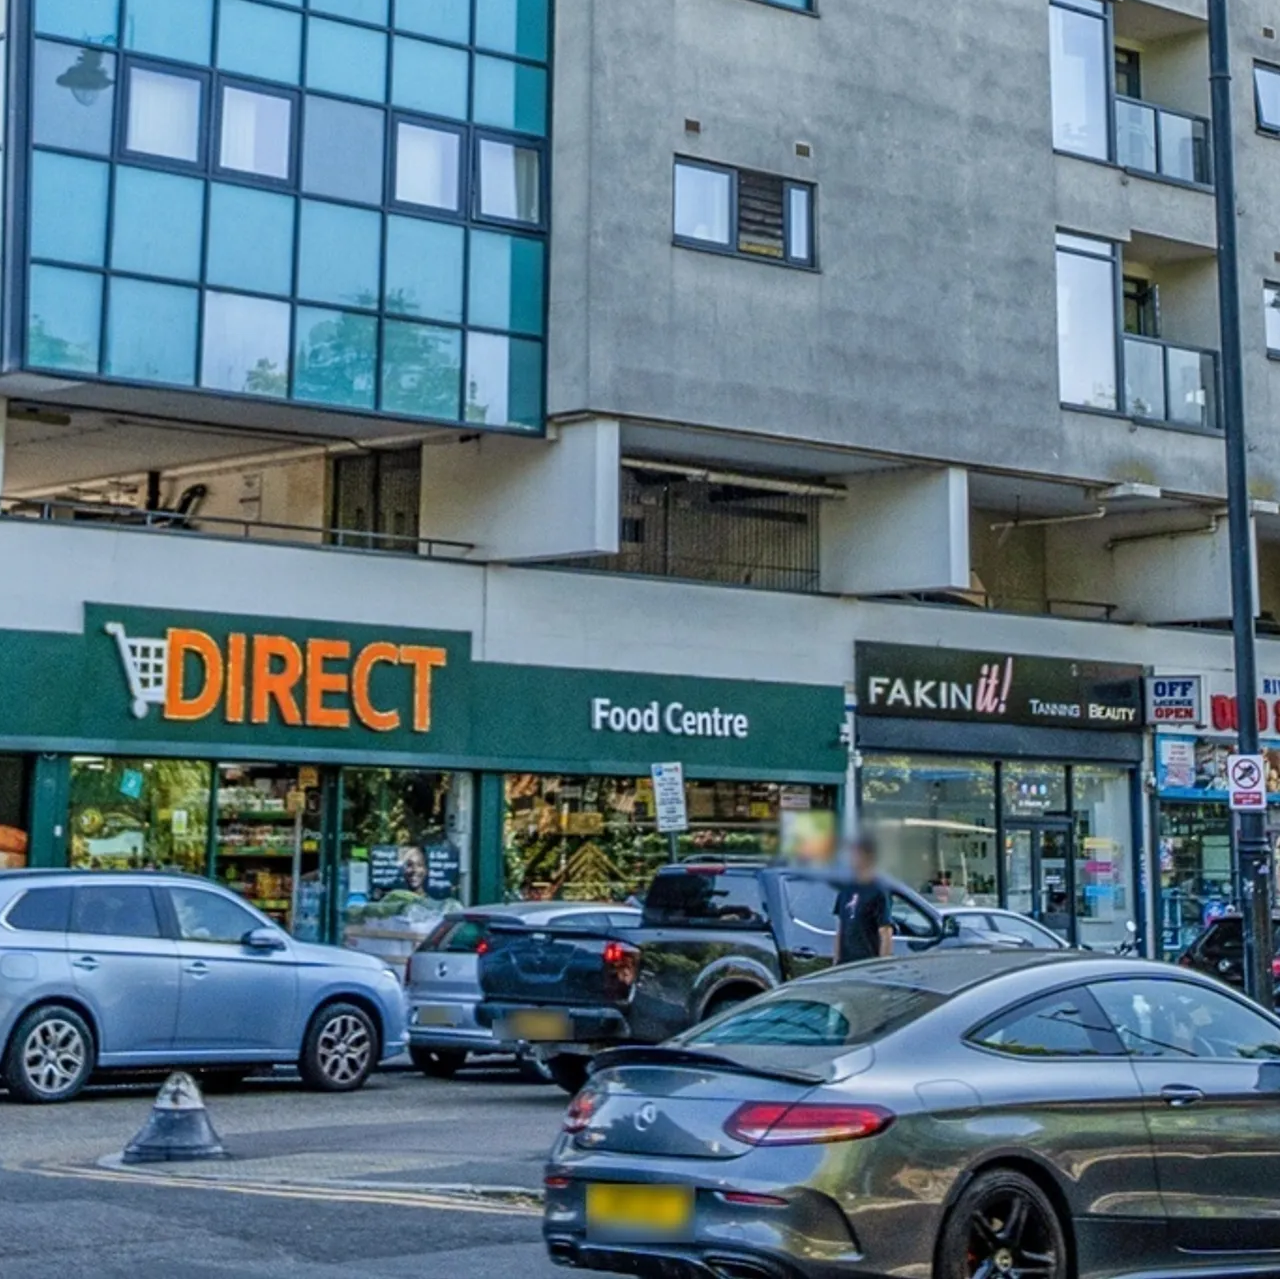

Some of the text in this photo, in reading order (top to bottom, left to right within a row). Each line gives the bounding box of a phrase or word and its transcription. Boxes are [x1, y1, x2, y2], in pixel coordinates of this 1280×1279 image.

[164, 627, 447, 733] DIRECT
[1154, 681, 1193, 697] OFF
[592, 697, 749, 739] Food Centre
[1155, 707, 1193, 719] OPEN
